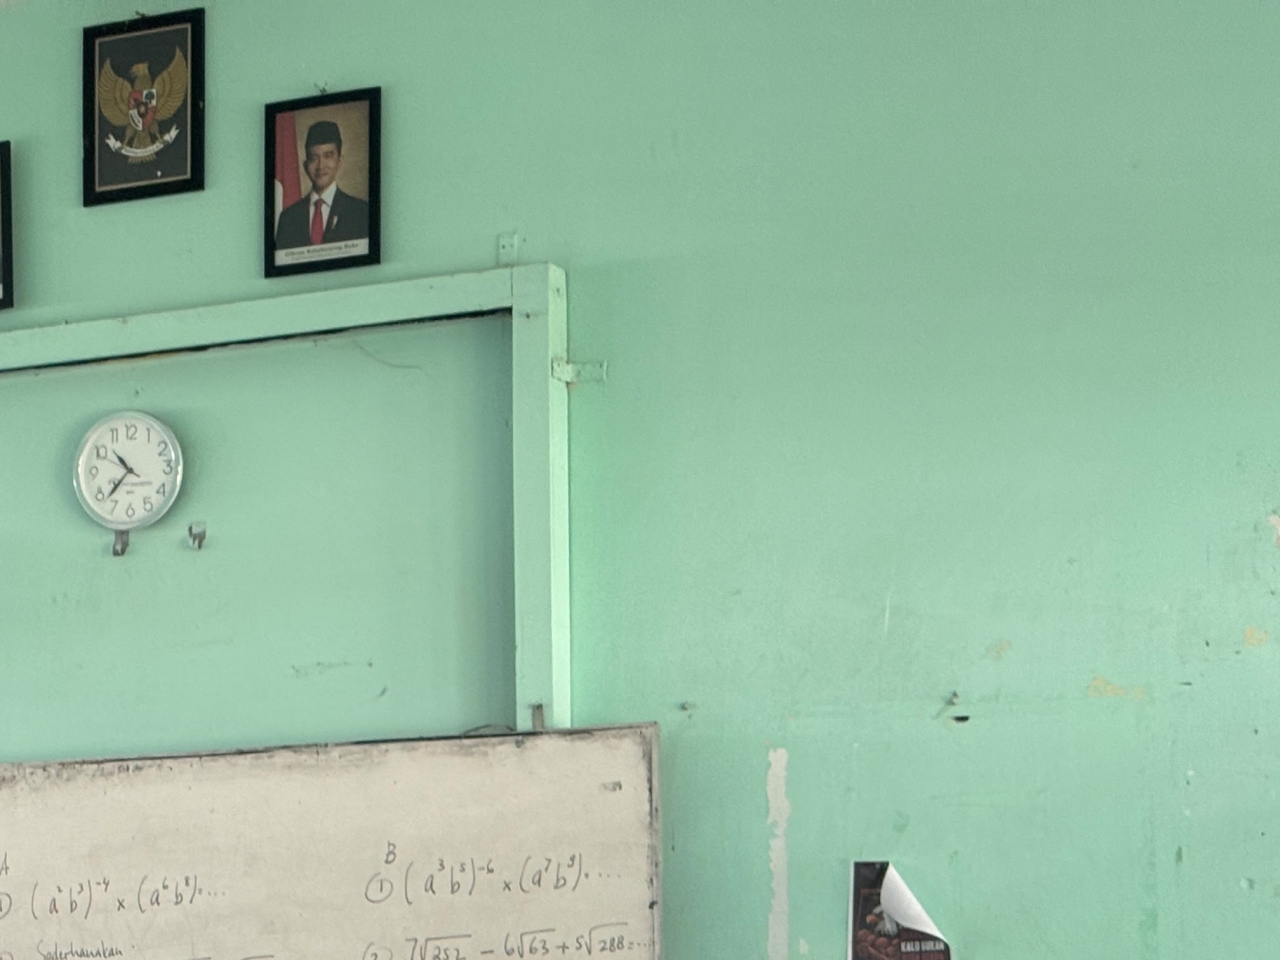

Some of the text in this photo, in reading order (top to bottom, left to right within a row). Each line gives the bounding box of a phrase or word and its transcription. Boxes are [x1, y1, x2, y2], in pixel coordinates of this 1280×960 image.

[109, 428, 119, 443] 11
[125, 422, 138, 440] 12
[95, 444, 108, 460] 10
[157, 441, 168, 457] 2
[89, 466, 99, 481] 9
[162, 459, 173, 475] 3
[95, 486, 105, 502] 8
[156, 483, 166, 497] 4
[109, 499, 119, 516] 7
[125, 502, 135, 518] 6
[143, 497, 154, 512] 5
[384, 840, 397, 865] B
[0, 851, 10, 877] A
